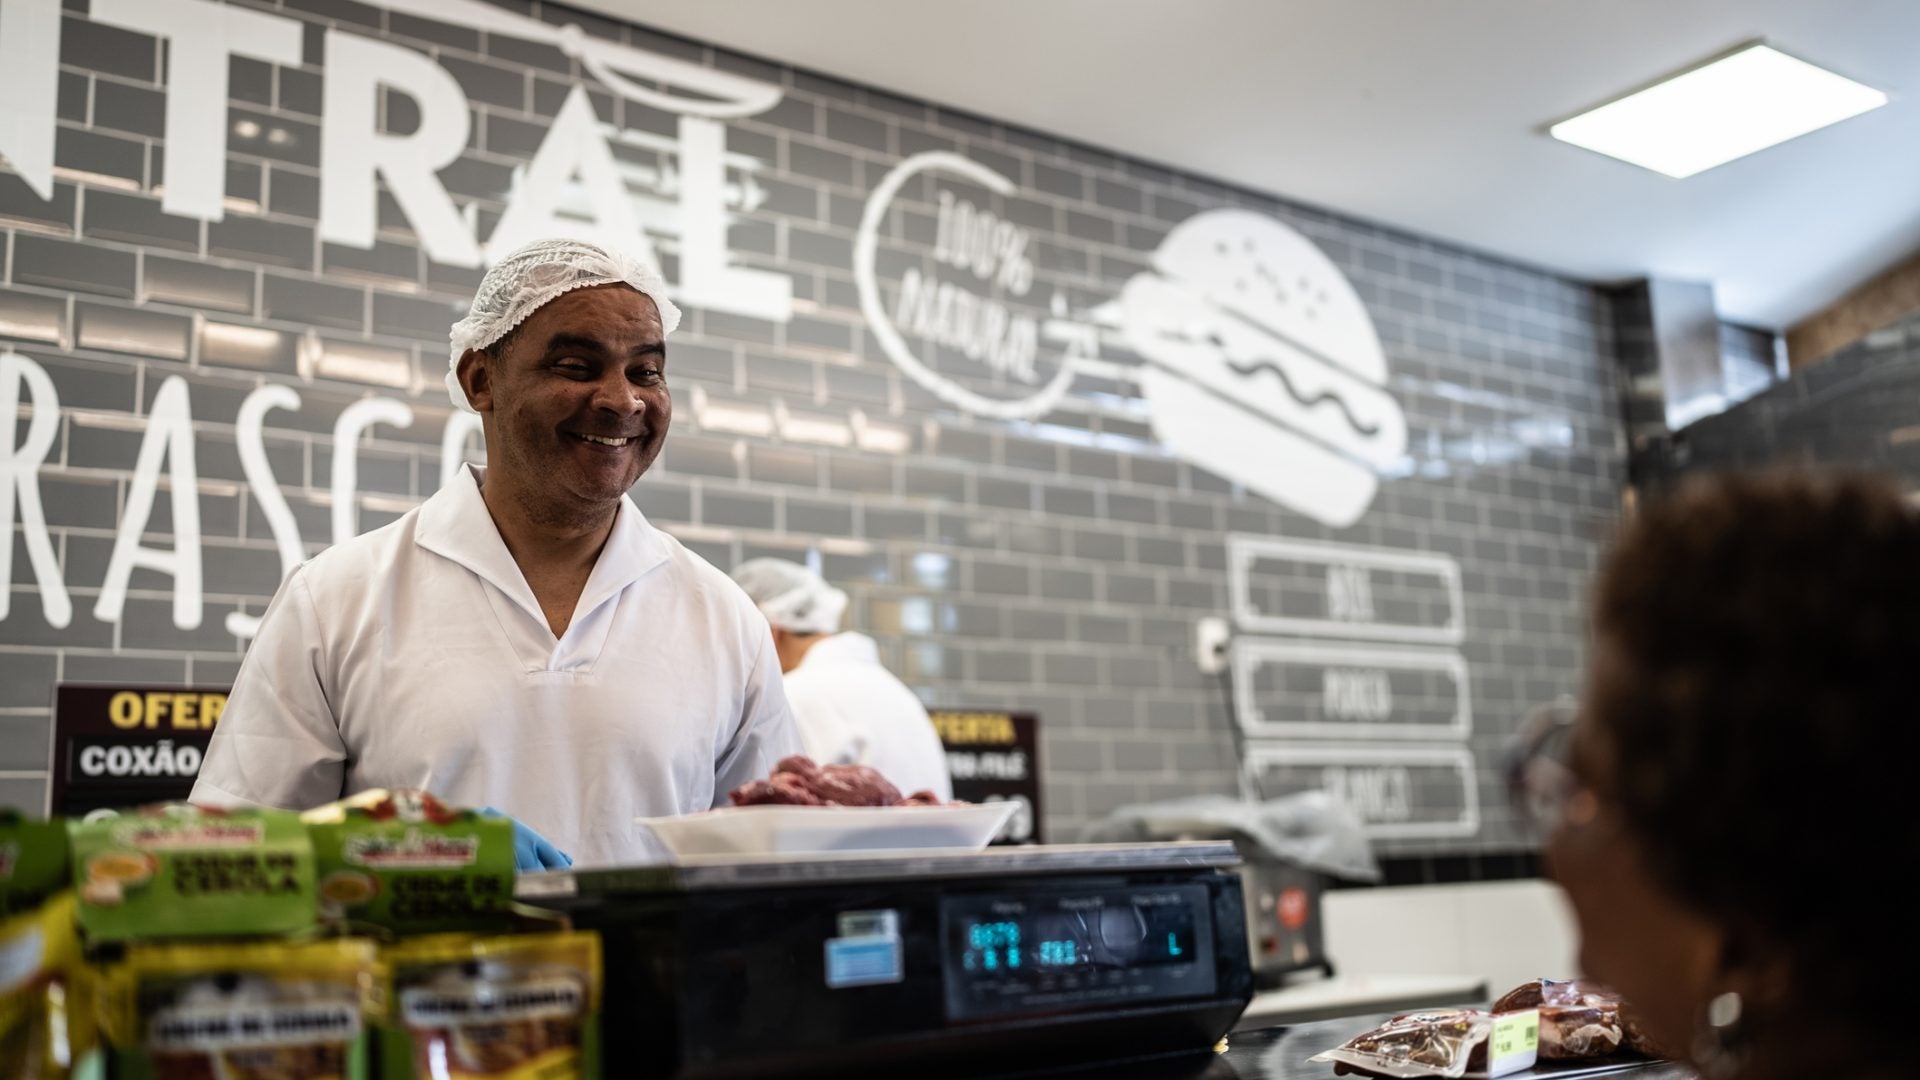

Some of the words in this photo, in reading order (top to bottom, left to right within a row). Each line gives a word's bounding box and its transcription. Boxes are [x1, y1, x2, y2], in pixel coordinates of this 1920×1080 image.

[934, 189, 1034, 297] 100%
[896, 266, 1041, 386] NATURAL
[108, 691, 229, 729] OFER
[80, 740, 201, 777] COXÃO
